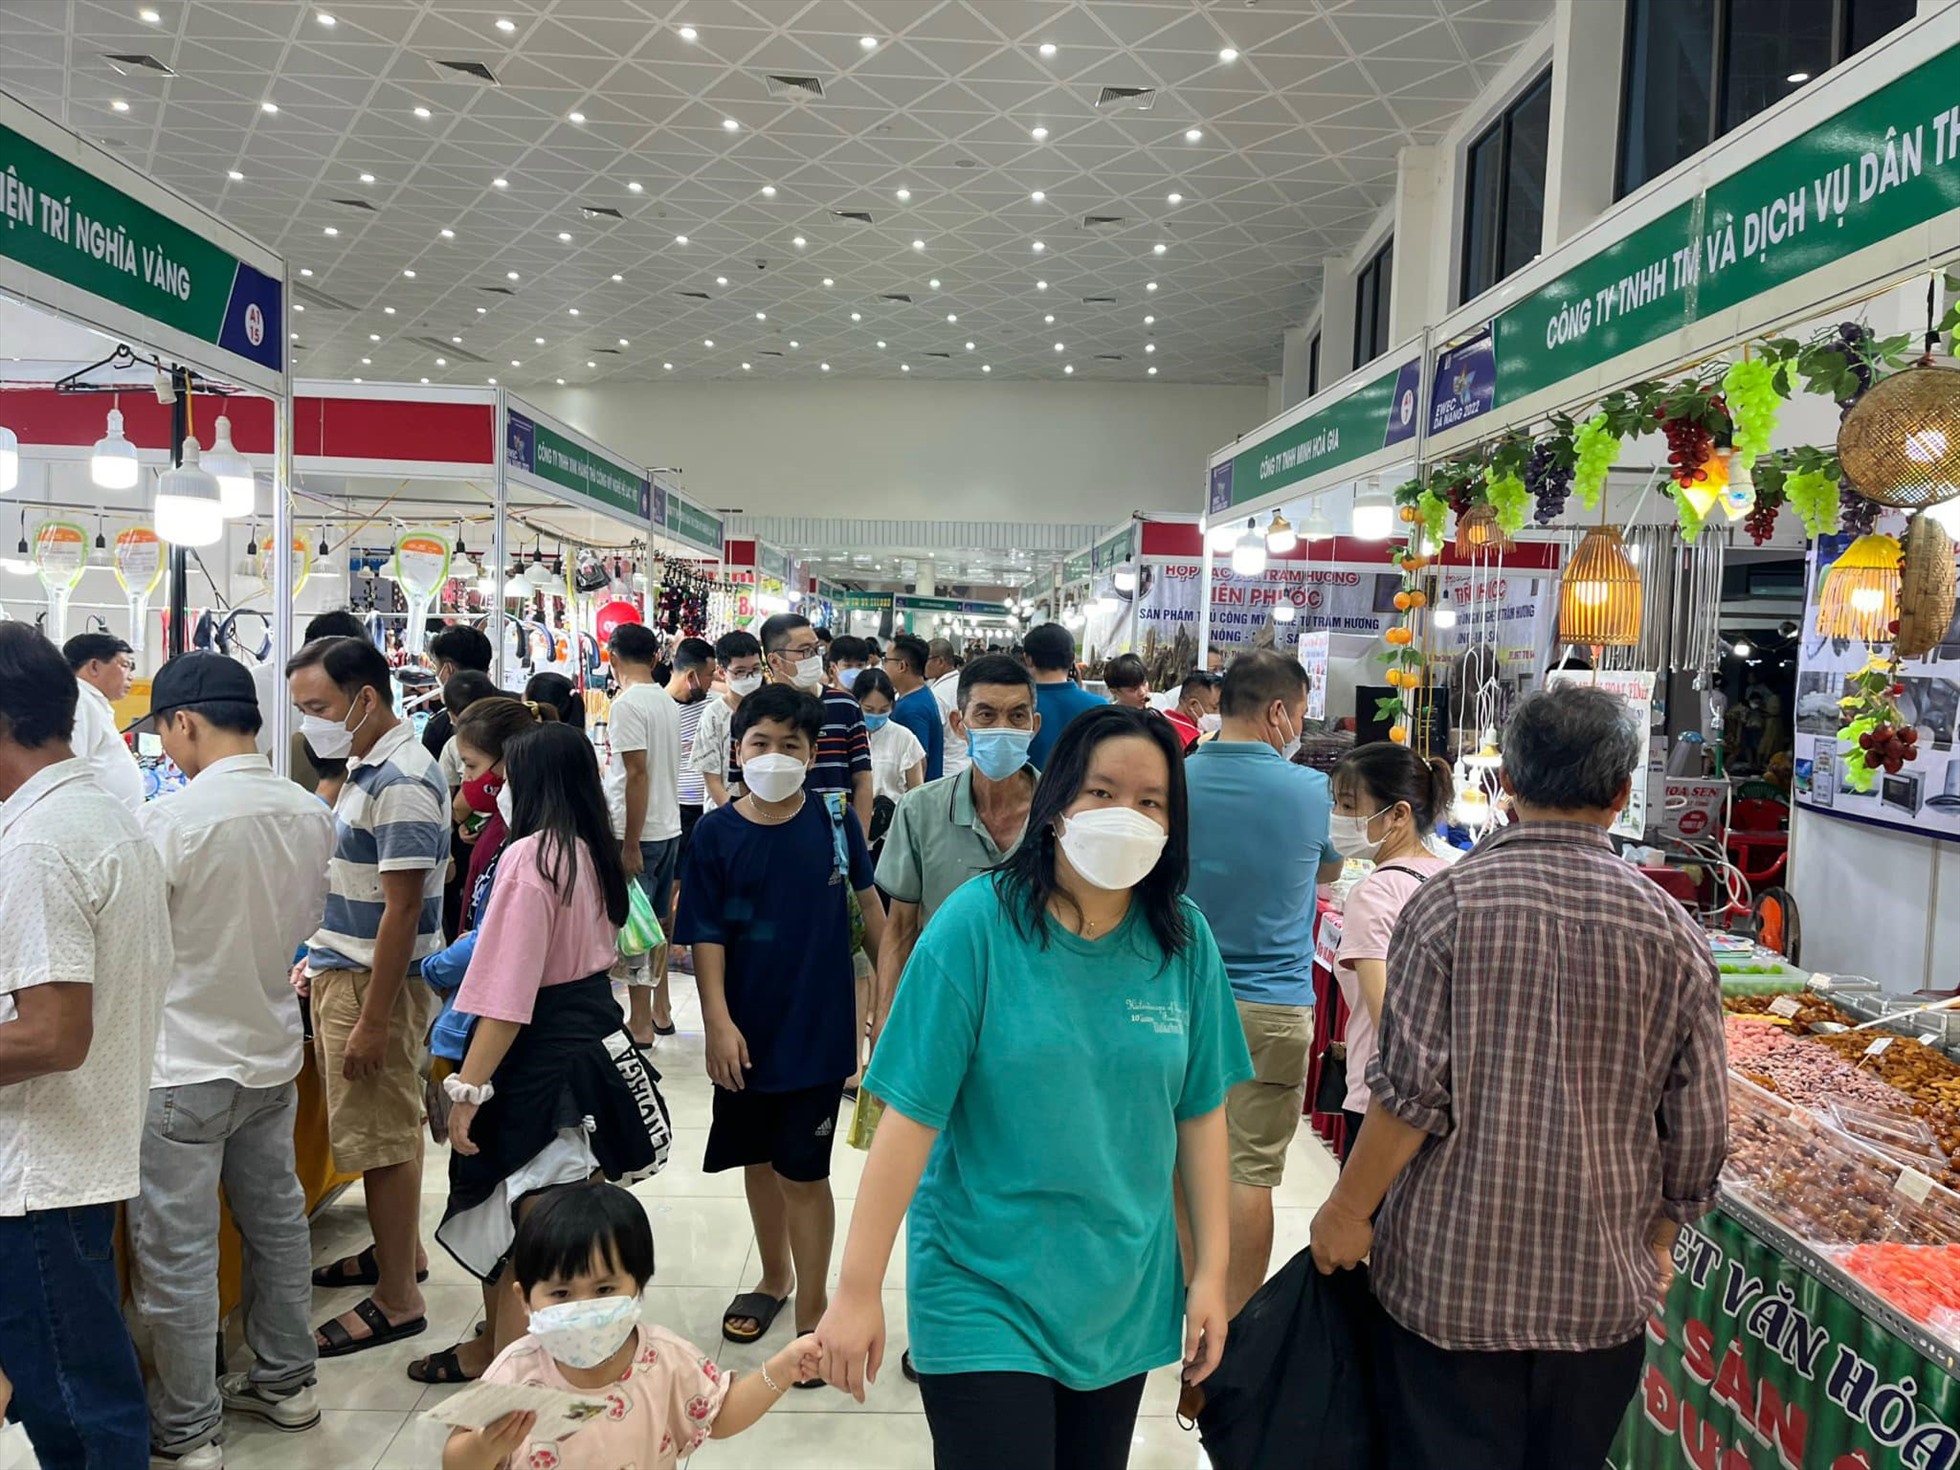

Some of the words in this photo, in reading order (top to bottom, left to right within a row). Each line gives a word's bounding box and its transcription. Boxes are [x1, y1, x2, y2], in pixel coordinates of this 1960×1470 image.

[39, 192, 72, 244] TRÍ
[75, 211, 138, 277] NGHĨA
[142, 244, 191, 302] VÀNG
[1546, 300, 1592, 351] CÔNG
[1595, 282, 1618, 328] TY
[1618, 263, 1667, 317] TNHH
[1705, 214, 1738, 275] VÀ
[1743, 185, 1807, 263] DỊCH
[1814, 162, 1852, 230] VỤ
[1858, 124, 1924, 204] DÂN
[249, 308, 261, 325] A1
[250, 325, 261, 342] 15
[537, 441, 552, 465] CÔNG
[1260, 454, 1275, 481] CÔNG
[1211, 582, 1244, 606] IÊN
[1219, 610, 1248, 625] CÔNG
